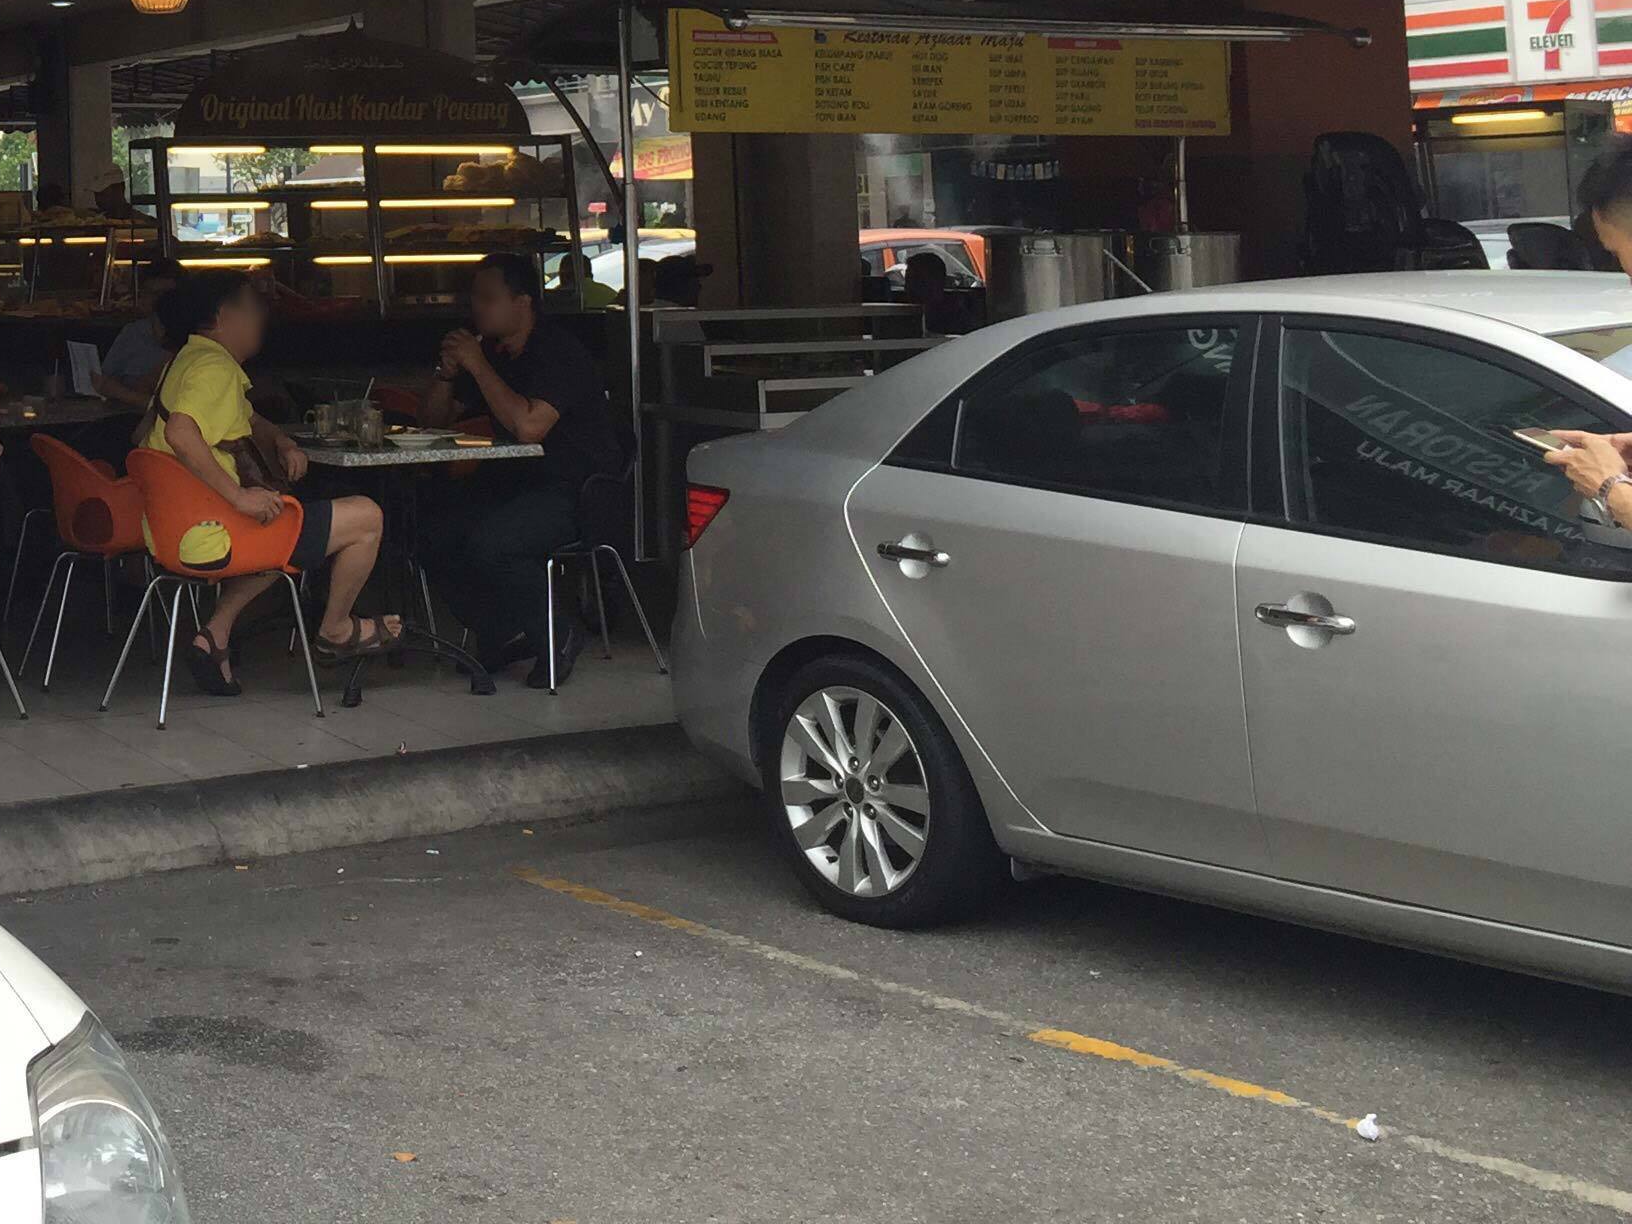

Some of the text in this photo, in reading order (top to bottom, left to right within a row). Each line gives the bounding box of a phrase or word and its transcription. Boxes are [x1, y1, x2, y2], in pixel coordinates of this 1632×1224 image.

[200, 93, 511, 129] Original Nasi Kandar Penang
